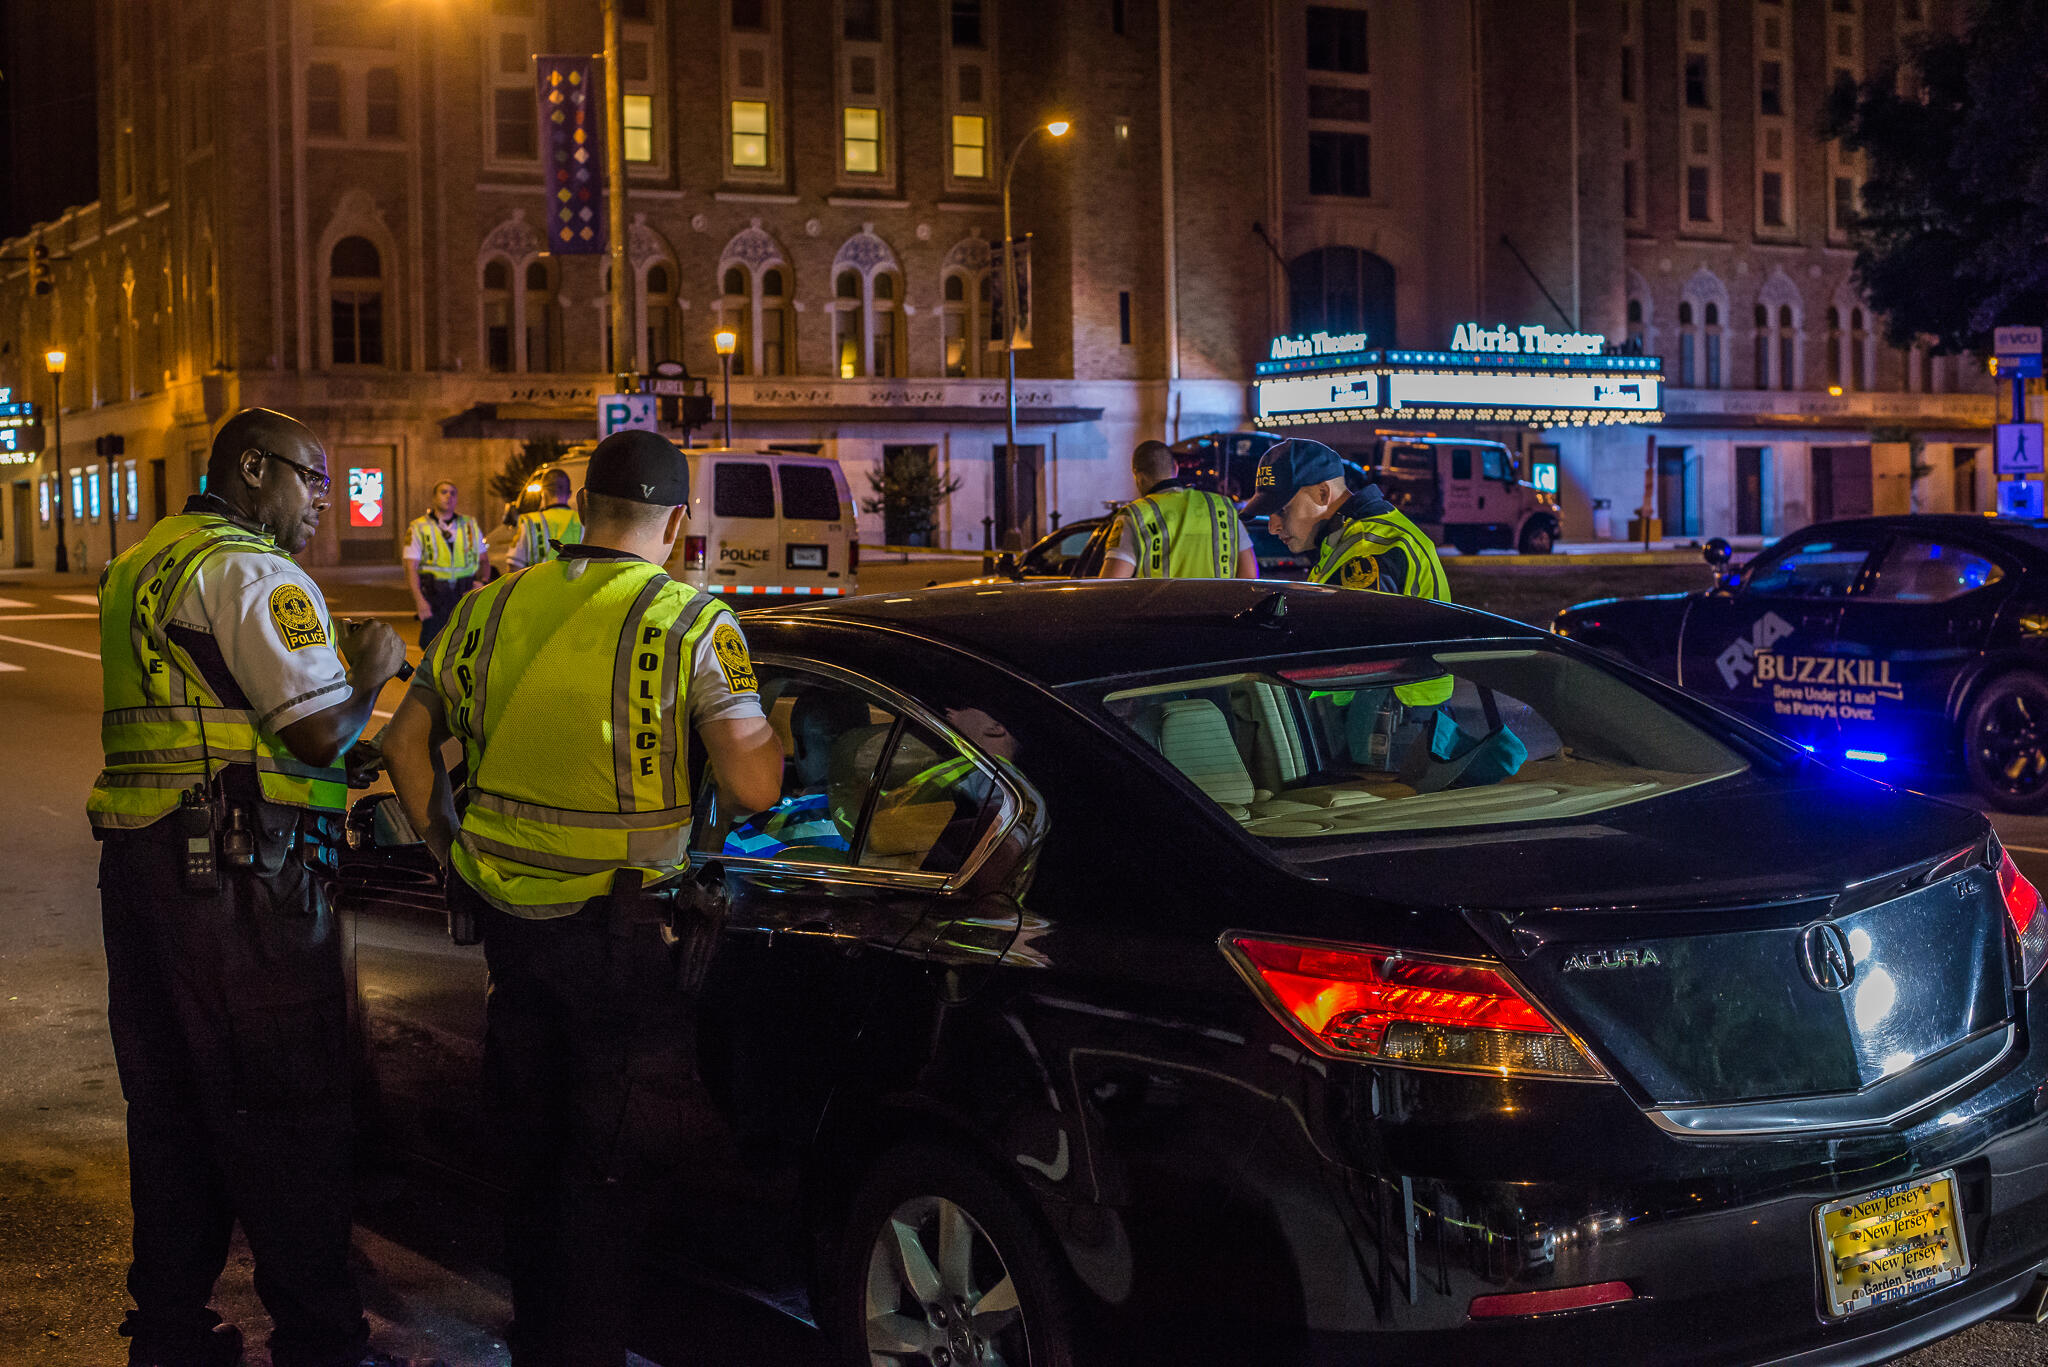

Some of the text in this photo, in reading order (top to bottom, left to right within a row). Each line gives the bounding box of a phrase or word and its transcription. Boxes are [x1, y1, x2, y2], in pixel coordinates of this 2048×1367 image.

[1271, 331, 1367, 359] Altria Theater
[1451, 322, 1604, 355] Altria Theater
[2009, 332, 2037, 345] VCU
[606, 403, 631, 435] P
[720, 549, 770, 561] POLICE
[1146, 522, 1160, 570] VCU
[1217, 510, 1229, 575] POLICE
[289, 632, 326, 647] POLICE
[1715, 611, 1795, 690] RVA
[456, 628, 481, 739] VCU
[1758, 654, 1902, 688] BUZZKILL
[636, 626, 662, 776] POLICE
[1773, 684, 1876, 705] Serve Under 21 and
[1774, 701, 1876, 720] the Party's Over.
[1562, 948, 1661, 973] ACURA
[1854, 1187, 1921, 1219] New Jersey
[1863, 1211, 1930, 1243] New Jersey
[1871, 1244, 1939, 1275] New Jersey
[1863, 1276, 1903, 1296] Garden
[1870, 1277, 1936, 1306] METRO Honda
